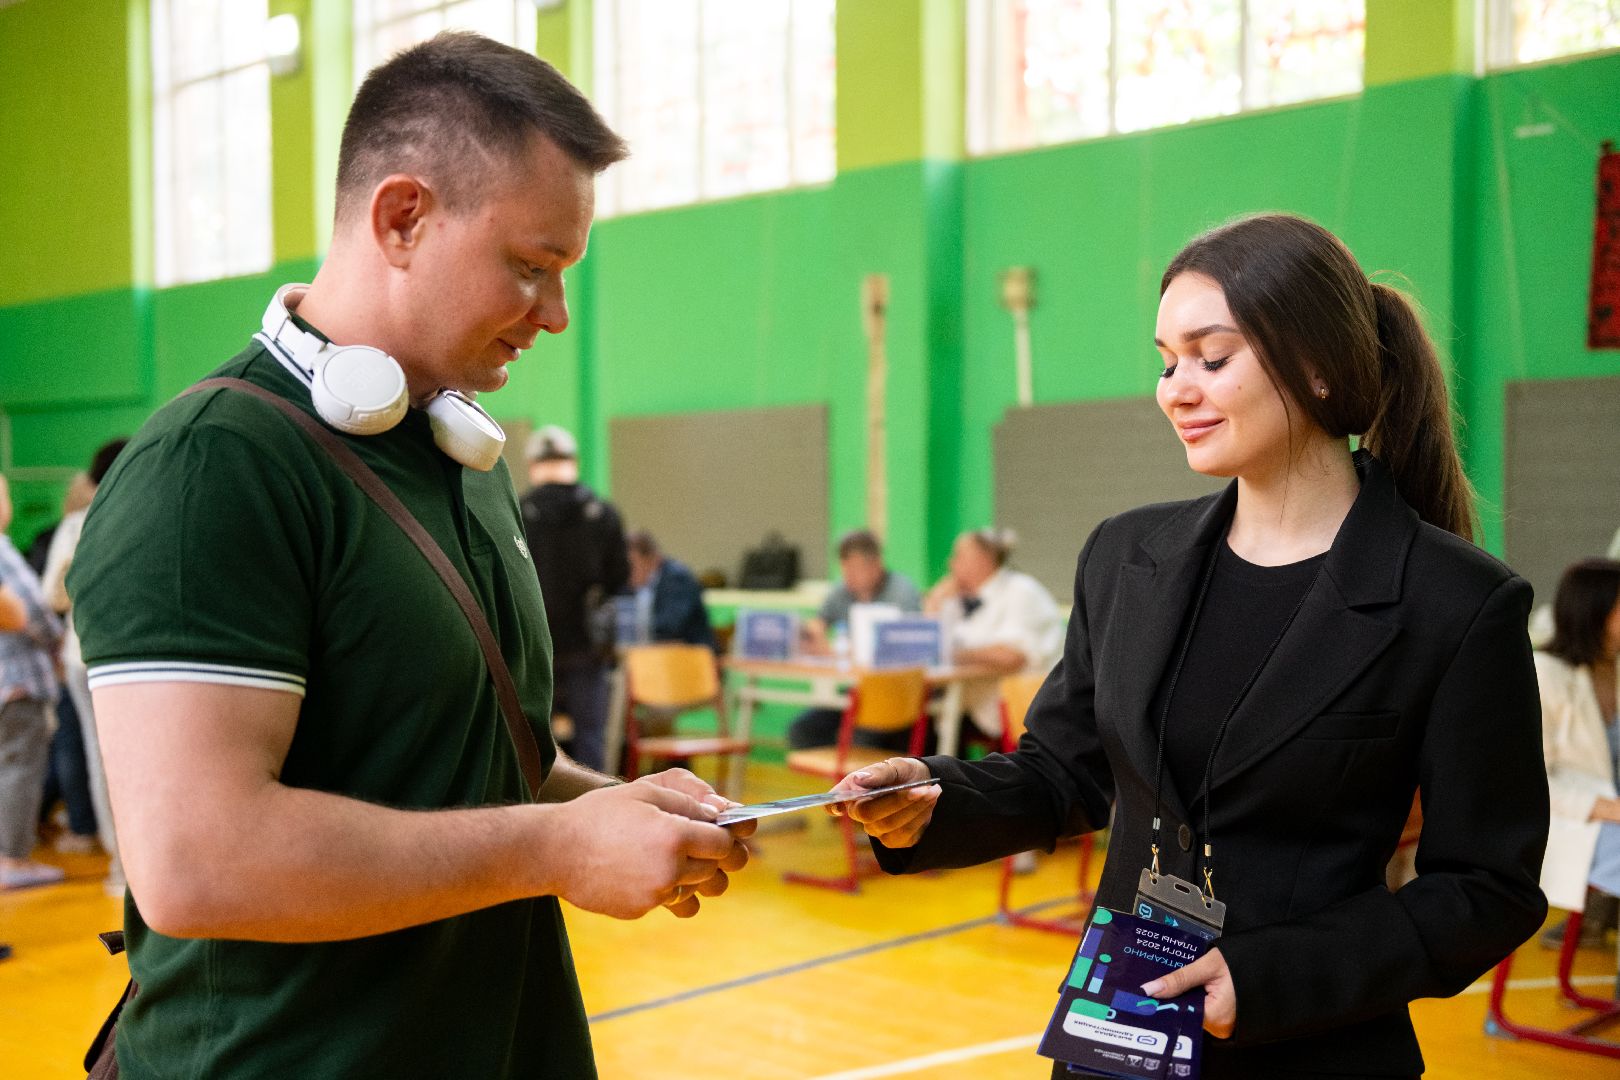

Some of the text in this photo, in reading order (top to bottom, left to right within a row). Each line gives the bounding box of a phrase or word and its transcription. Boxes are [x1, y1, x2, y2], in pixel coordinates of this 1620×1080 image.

[1135, 927, 1198, 952] ПЛАНЫ 2025
[1136, 938, 1195, 961] ИТОГИ 2024
[1123, 946, 1187, 968] ЫТКАРИНО
